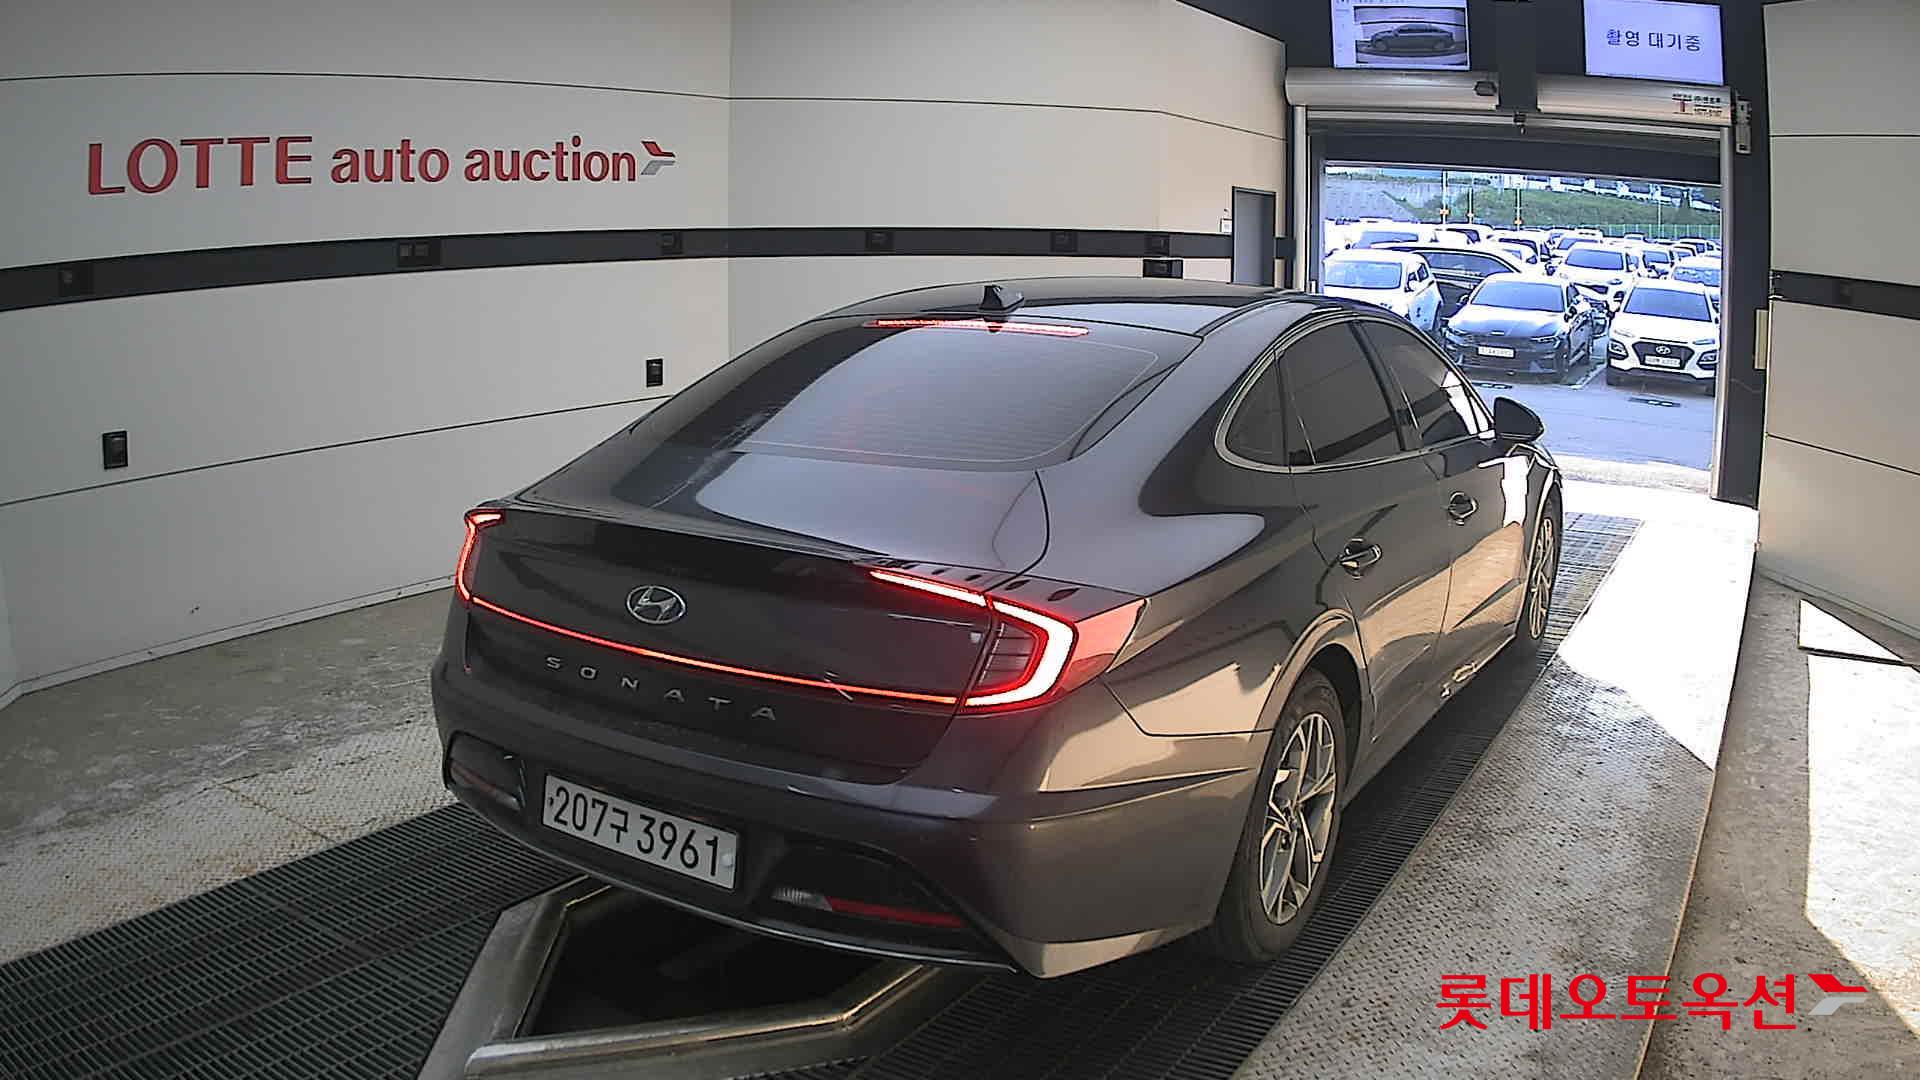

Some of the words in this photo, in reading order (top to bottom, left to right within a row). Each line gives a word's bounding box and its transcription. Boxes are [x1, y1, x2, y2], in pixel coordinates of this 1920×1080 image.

[1648, 32, 1701, 52] 대기중
[88, 136, 313, 195] LOTTE
[331, 138, 450, 183] auto
[464, 136, 638, 183] auction
[545, 655, 776, 721] SONATA
[553, 785, 630, 844] 207구
[636, 813, 720, 877] 3961
